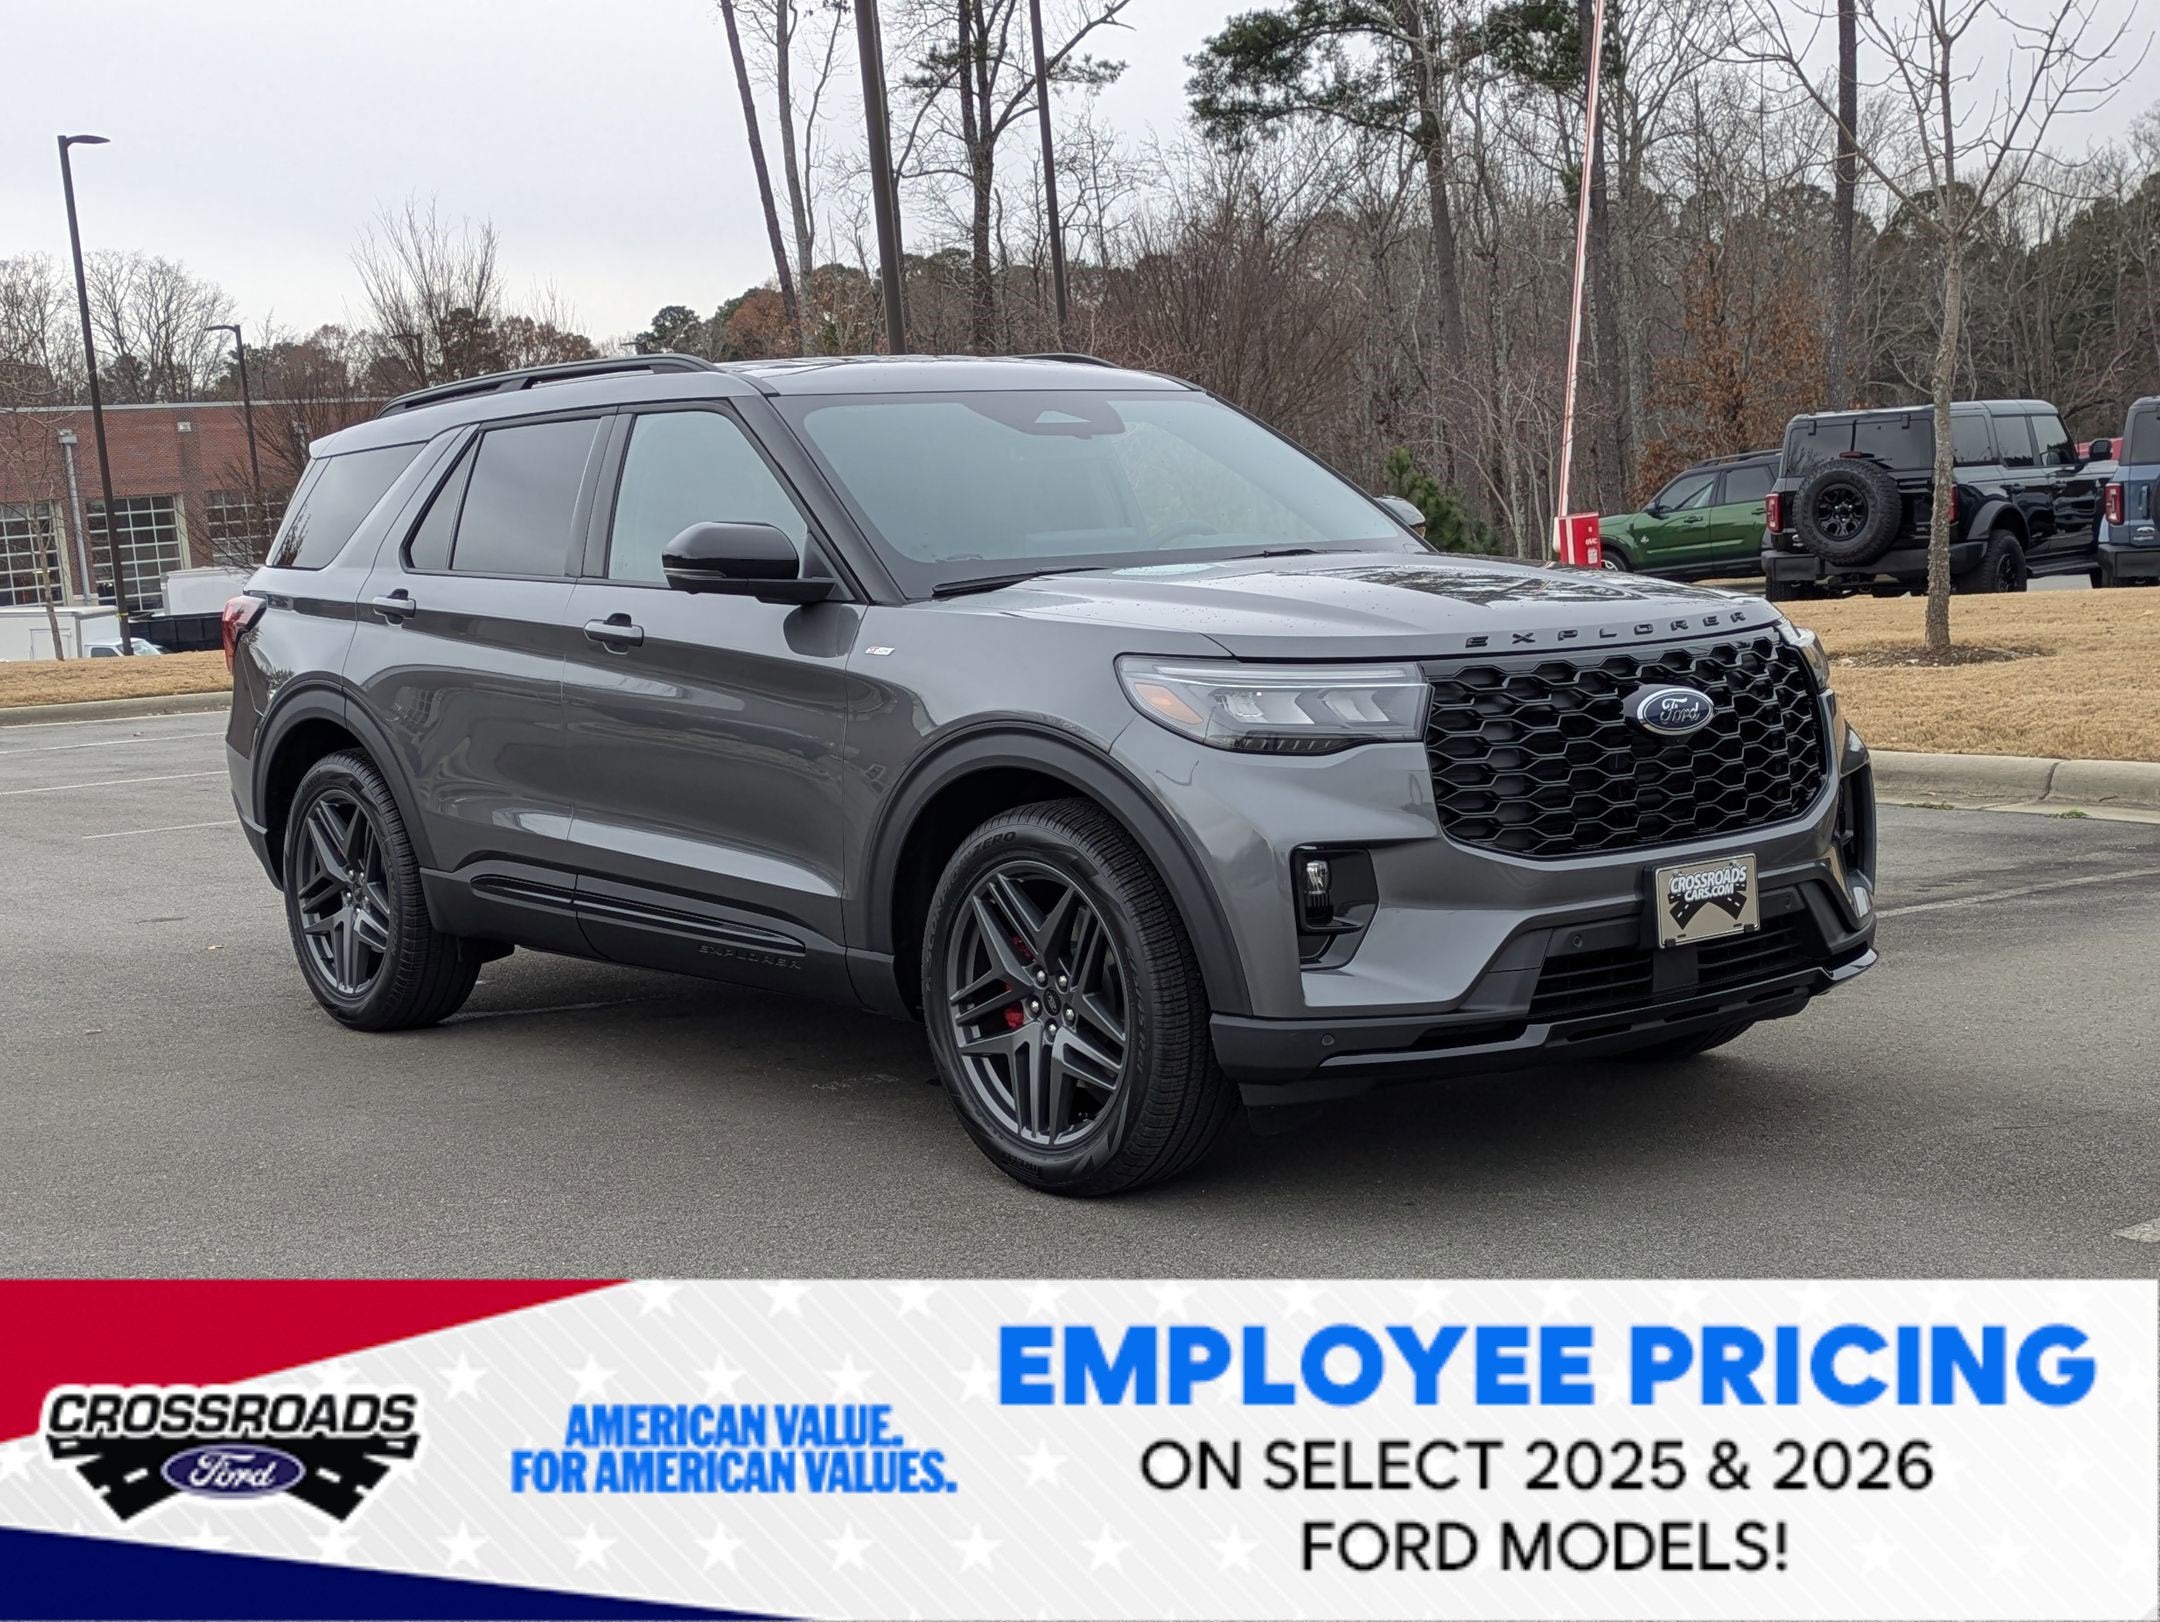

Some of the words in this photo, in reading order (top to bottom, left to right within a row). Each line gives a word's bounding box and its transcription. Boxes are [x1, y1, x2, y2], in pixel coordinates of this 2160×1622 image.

[1465, 611, 1746, 648] EXPLORER
[1660, 697, 1701, 724] Ford
[1669, 864, 1747, 894] CROSSROADS
[1684, 883, 1735, 902] CARS.COM
